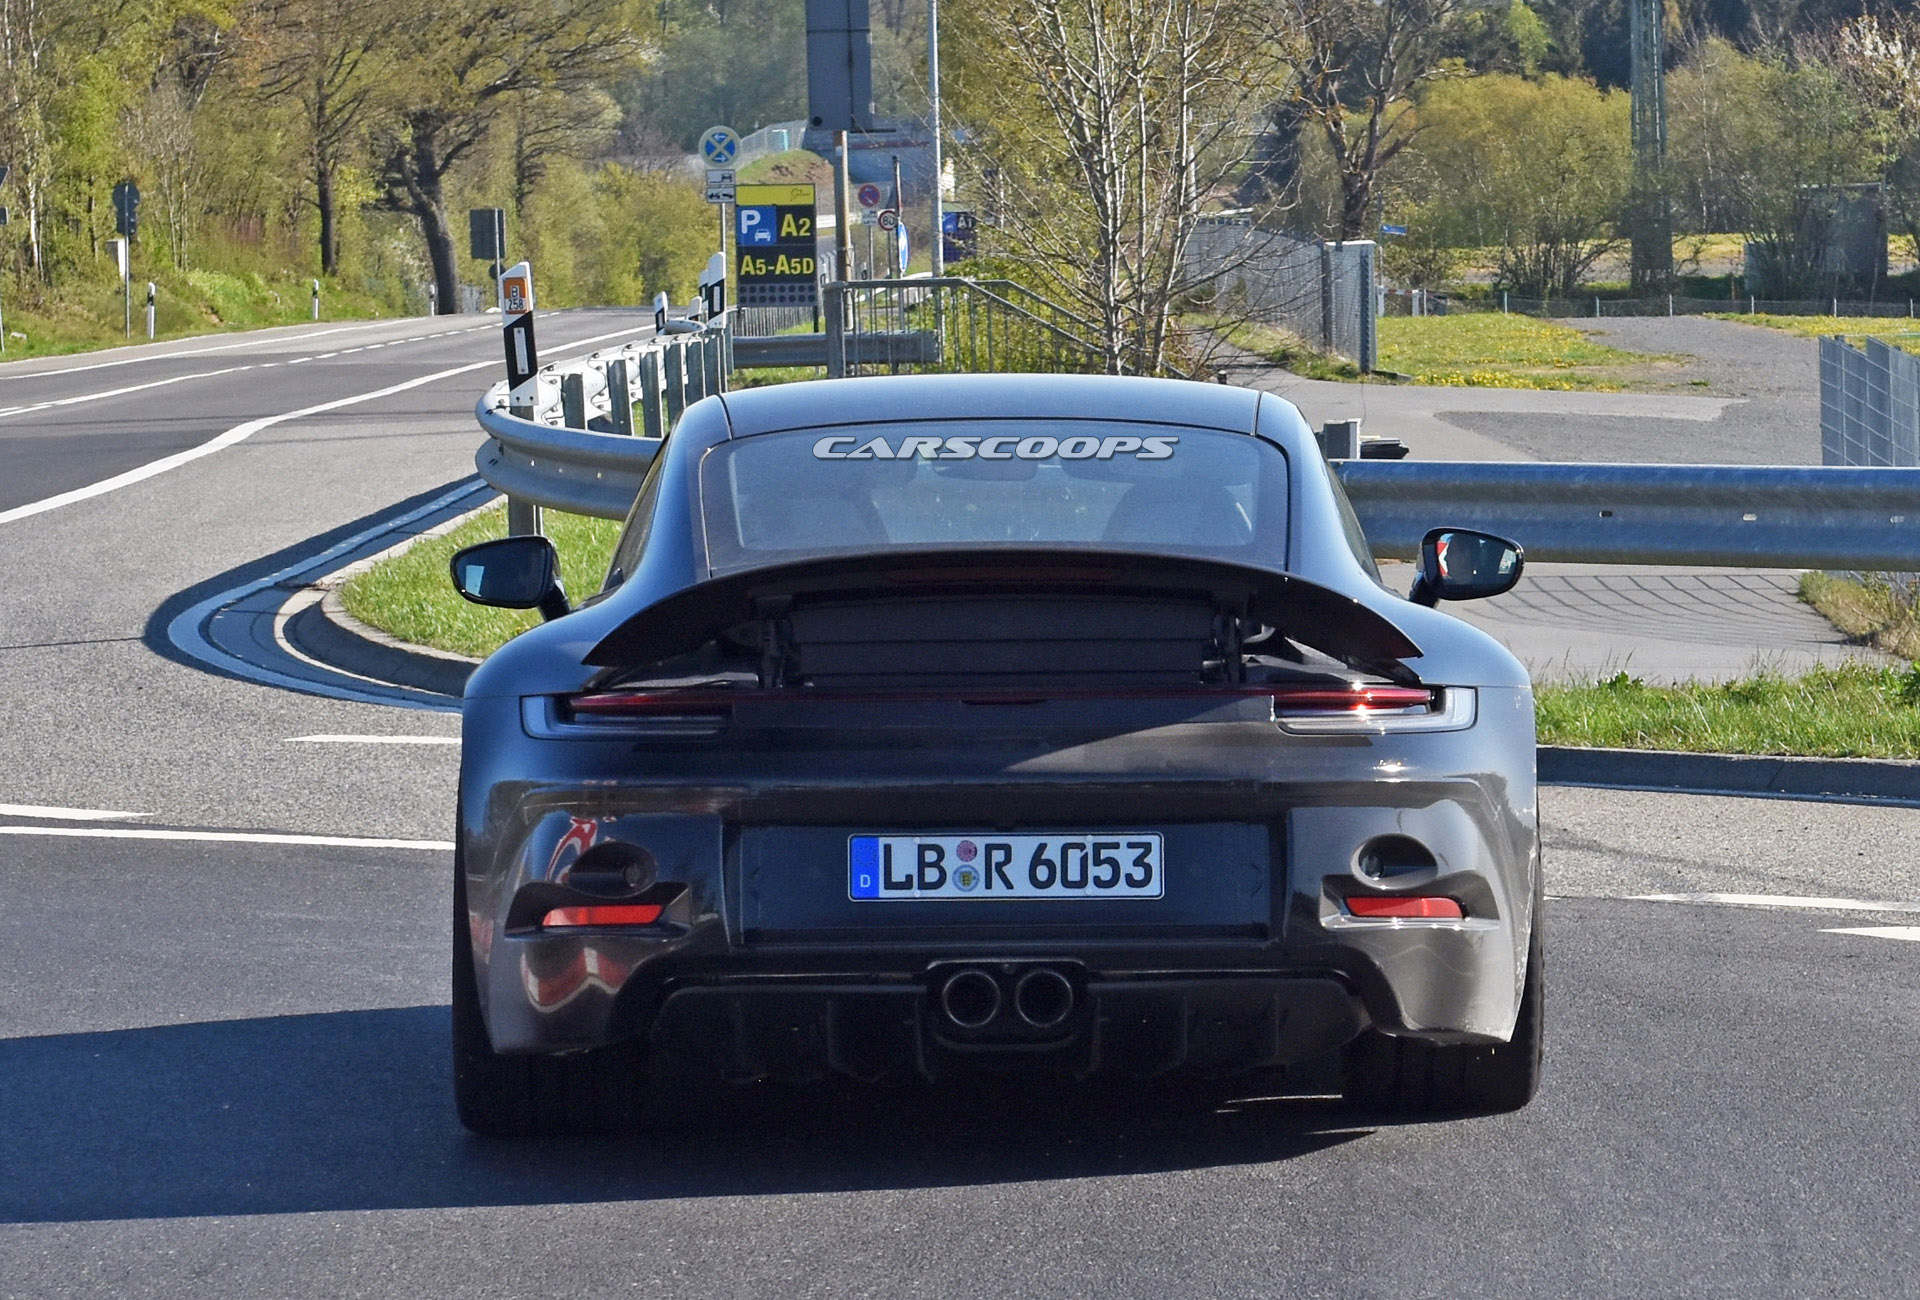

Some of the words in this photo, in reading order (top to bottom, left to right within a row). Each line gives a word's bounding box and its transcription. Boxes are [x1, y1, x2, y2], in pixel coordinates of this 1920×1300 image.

[741, 210, 761, 234] P
[780, 213, 811, 237] A2
[740, 254, 815, 275] A5-A5D
[508, 299, 524, 310] 258
[883, 843, 947, 890] LB
[984, 843, 1014, 890] R
[1028, 842, 1152, 889] 6053
[860, 874, 871, 888] D
